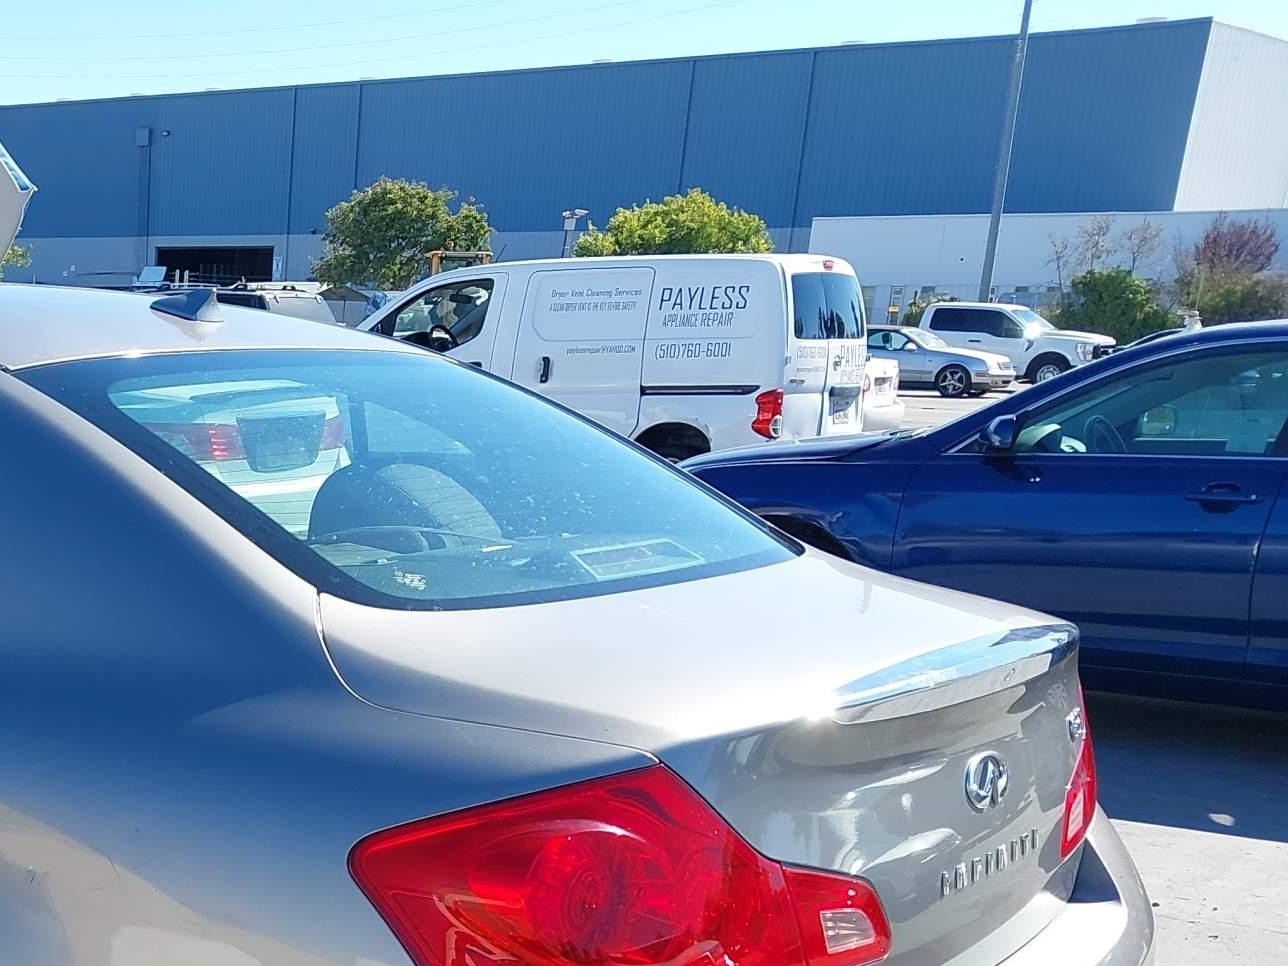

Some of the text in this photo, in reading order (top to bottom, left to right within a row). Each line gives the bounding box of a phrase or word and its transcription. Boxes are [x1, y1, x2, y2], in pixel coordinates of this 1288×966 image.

[551, 287, 642, 299] Dryer Vent Cleaning Services
[658, 286, 750, 311] PAYLESS
[662, 312, 734, 328] APPLIANCE REPAIR
[655, 342, 732, 360] (510)760-6001
